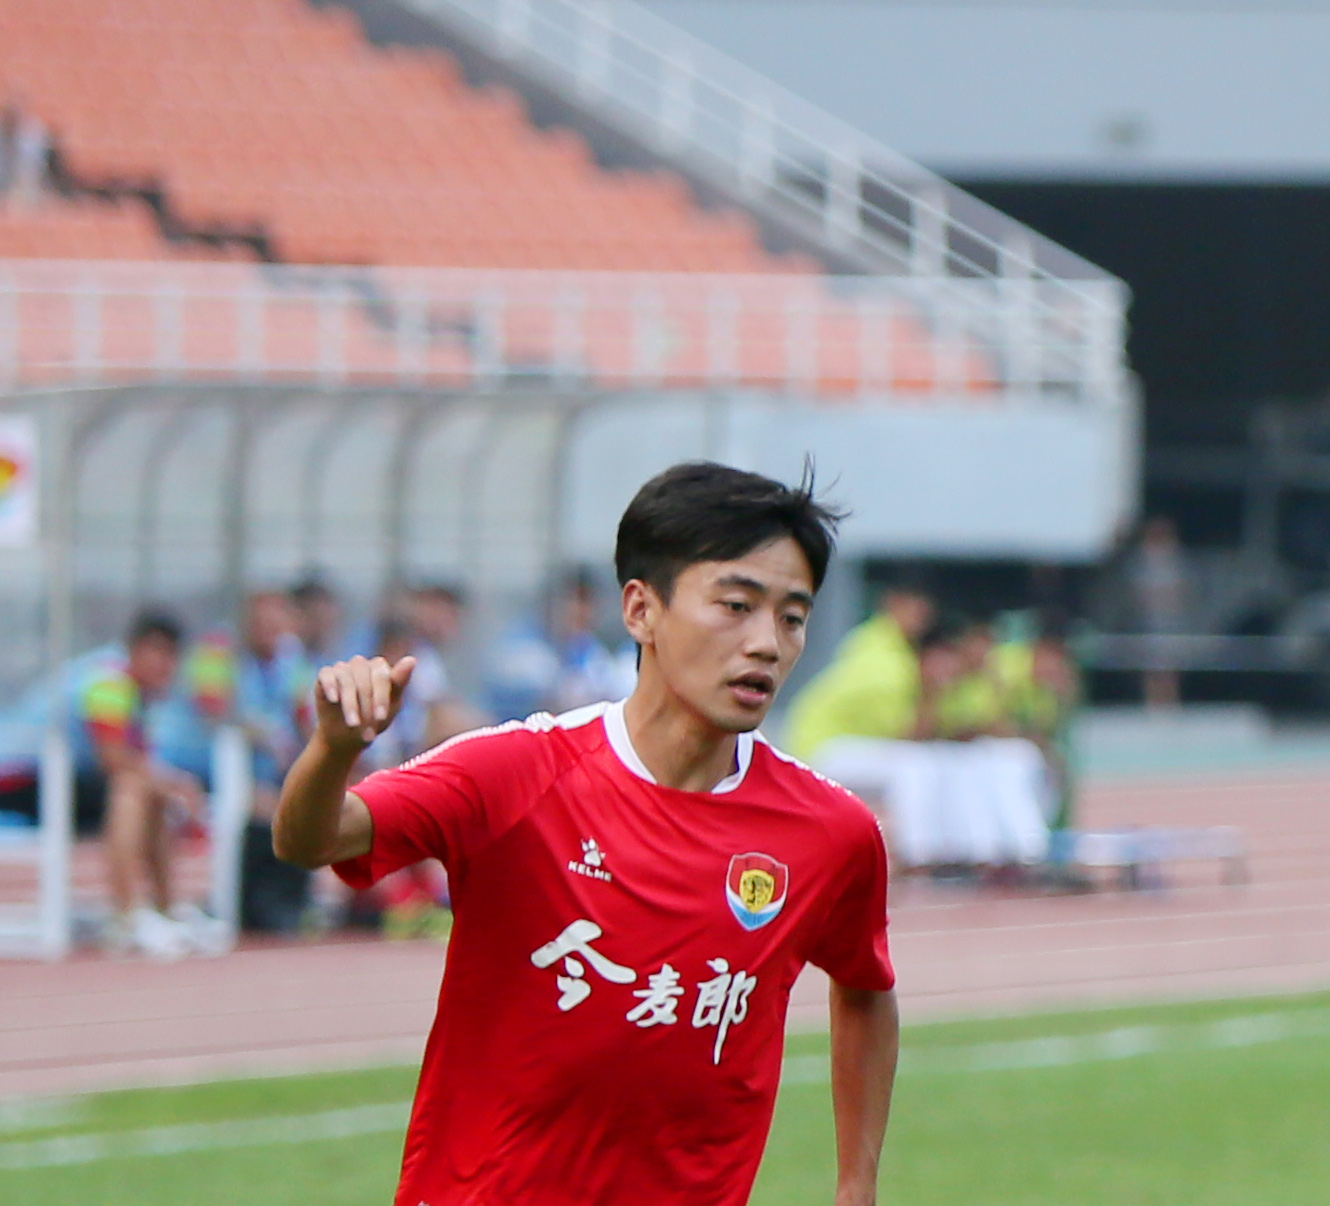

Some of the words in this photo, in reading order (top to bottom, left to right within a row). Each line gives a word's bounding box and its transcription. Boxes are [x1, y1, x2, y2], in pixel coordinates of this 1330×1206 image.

[568, 860, 612, 882] KELME
[530, 918, 758, 1065] 今麦郎
